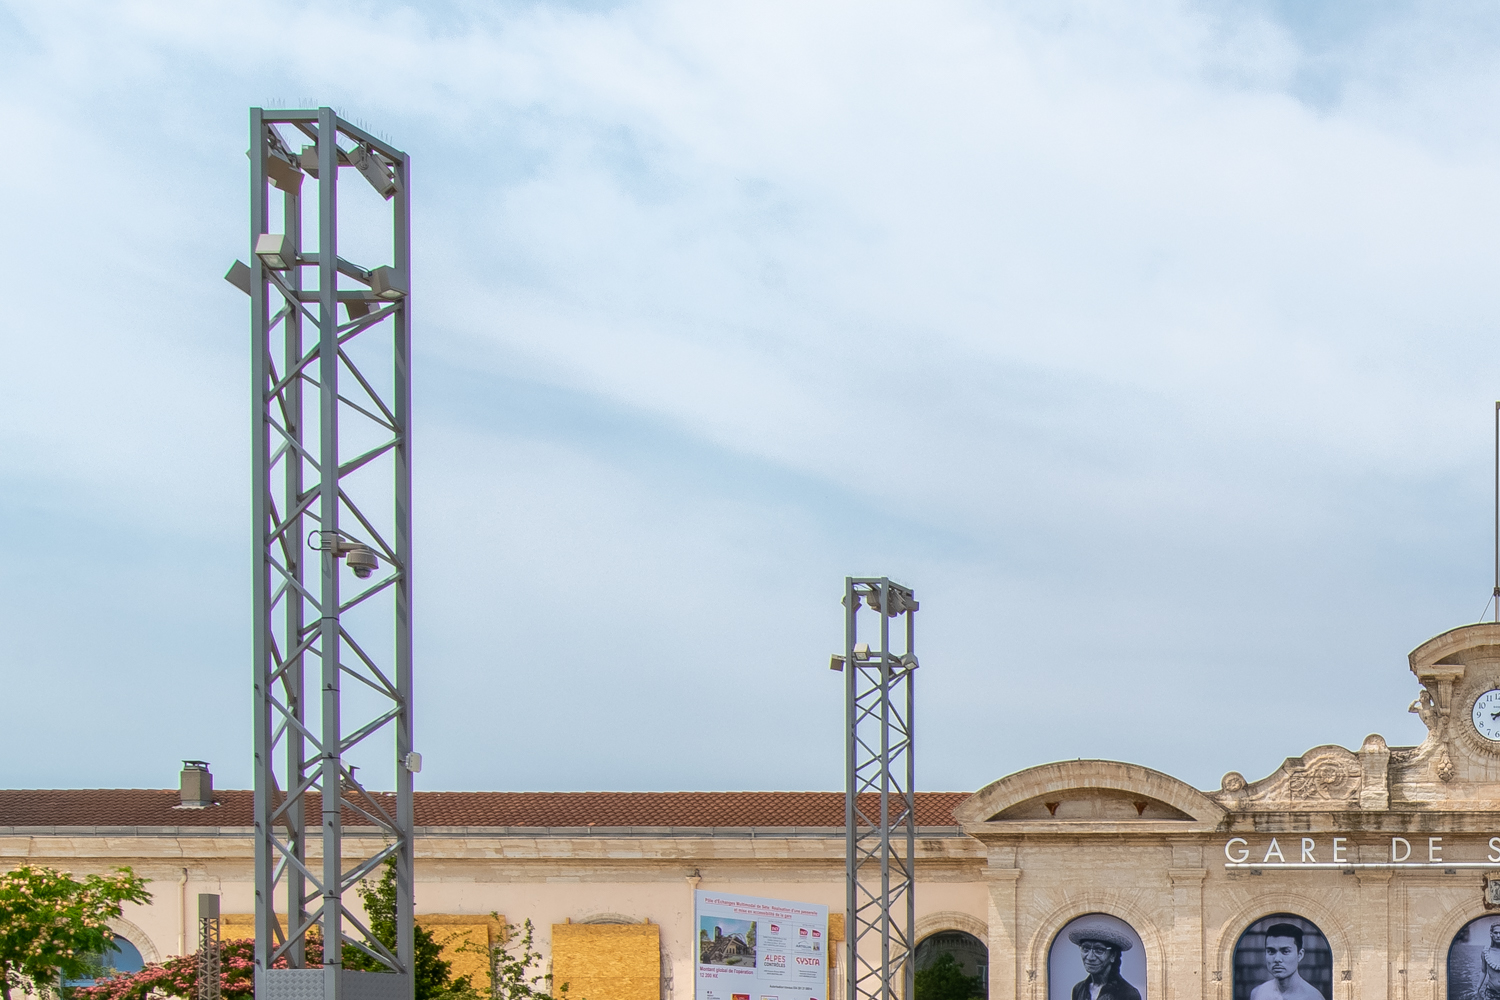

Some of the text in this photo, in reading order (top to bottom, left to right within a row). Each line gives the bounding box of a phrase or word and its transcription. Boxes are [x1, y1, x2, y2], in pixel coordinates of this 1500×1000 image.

[1224, 837, 1347, 863] GARE
[1392, 837, 1443, 862] DE
[765, 954, 786, 962] ALPES
